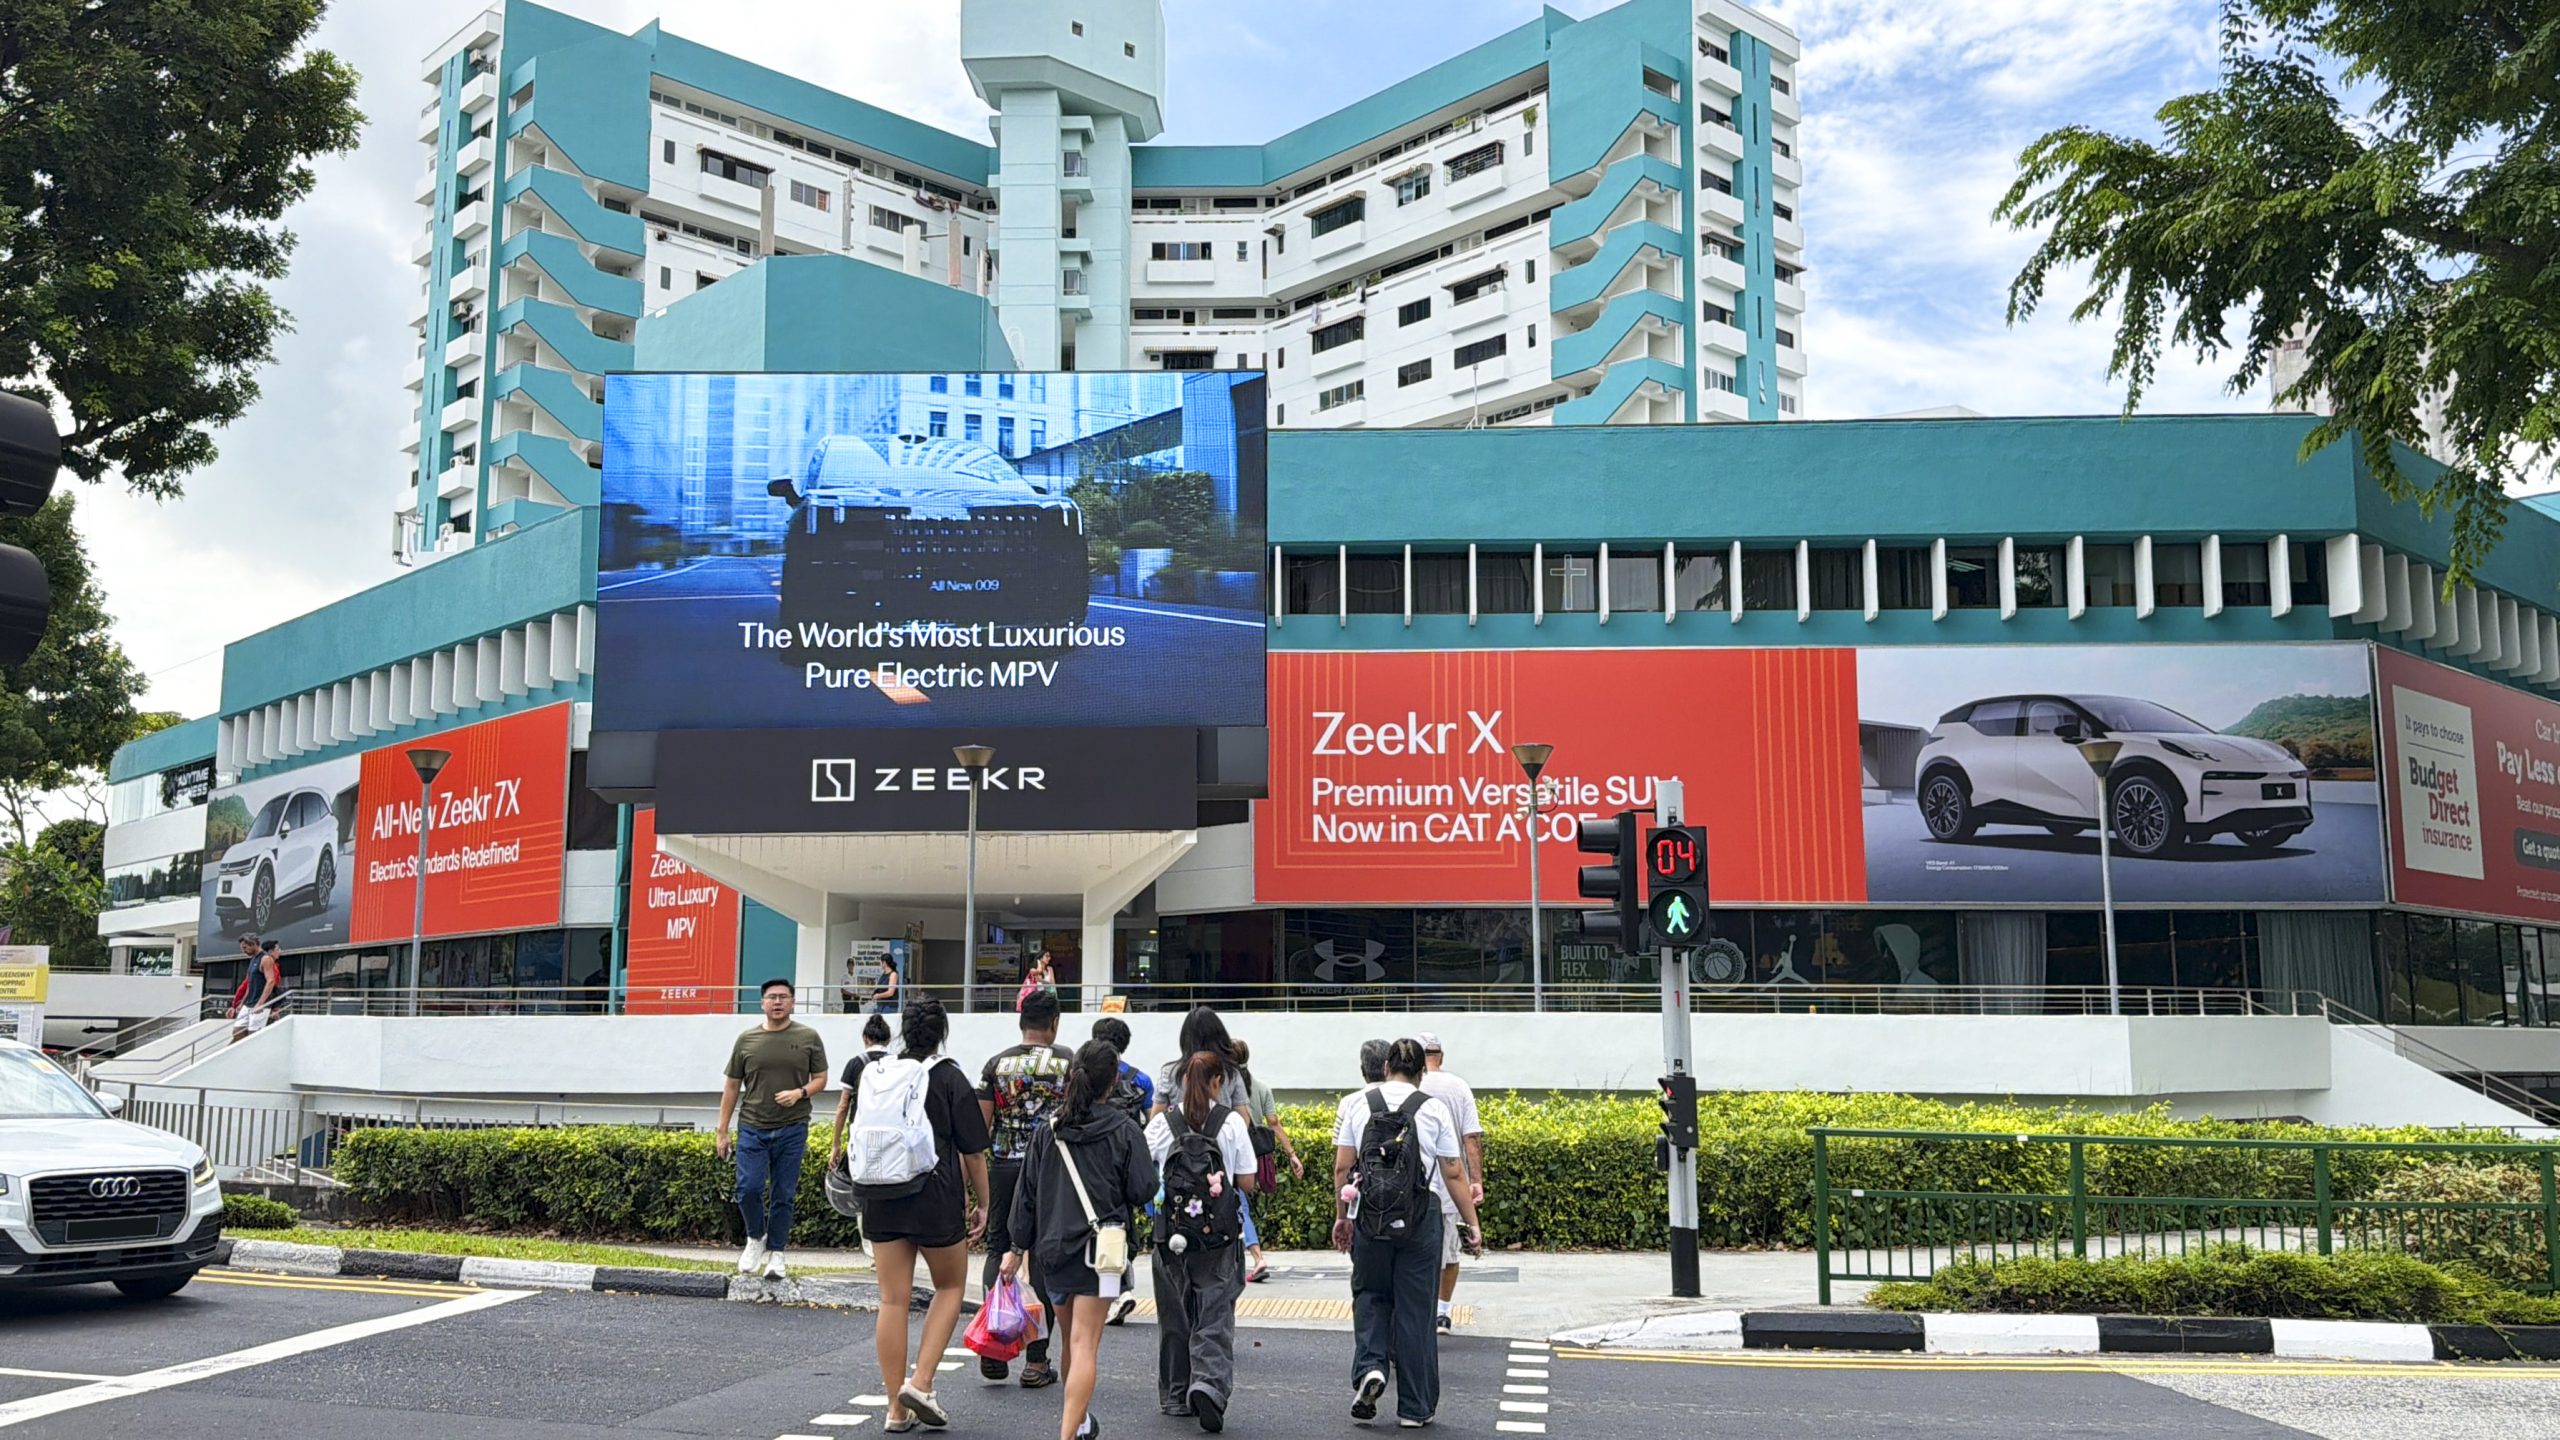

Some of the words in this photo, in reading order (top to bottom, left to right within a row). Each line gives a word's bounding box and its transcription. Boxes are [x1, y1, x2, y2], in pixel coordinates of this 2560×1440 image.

[975, 579, 1000, 591] 009
[738, 622, 792, 648] The
[798, 621, 903, 648] World's
[911, 622, 982, 648] Most
[988, 621, 1126, 648] Luxurious
[805, 662, 871, 688] Pure
[877, 661, 984, 688] Electric
[990, 661, 1059, 687] MPV
[1312, 711, 1457, 756] Zeekr
[1466, 710, 1506, 755] X
[2412, 717, 2430, 738] pays
[2430, 722, 2439, 736] to
[2439, 725, 2465, 745] choose
[2496, 740, 2523, 785] Pay
[2524, 748, 2555, 785] Less
[874, 767, 1046, 791] ZEEKR
[2408, 756, 2460, 797] Budget
[438, 786, 492, 830] Zeekr
[494, 777, 522, 819] 7X
[1312, 777, 1453, 807] Premium
[1458, 775, 1600, 807] Versatile
[2428, 791, 2471, 828] Direct
[1312, 813, 1388, 843] Now
[1390, 813, 1418, 843] in
[1423, 812, 1492, 843] CAT
[1495, 813, 1522, 842] A
[1526, 812, 1598, 842] CO
[2421, 822, 2472, 852] insurance
[1657, 839, 1696, 875] 04
[2522, 837, 2536, 856] Get
[369, 857, 407, 884] Electric
[406, 848, 461, 878] Stndards
[461, 837, 520, 870] Redefined
[648, 886, 677, 909] Ultra
[677, 884, 719, 908] Luxury
[666, 916, 697, 940] MPV
[1560, 944, 1592, 960] BUILT
[1592, 945, 1609, 960] TO
[1561, 961, 1592, 977] FLEX.
[660, 988, 697, 1000] ZEEKR
[1300, 986, 1341, 994] UNDER
[1343, 985, 1399, 994] ARMOUR
[1561, 996, 1601, 1010] DRVE.
